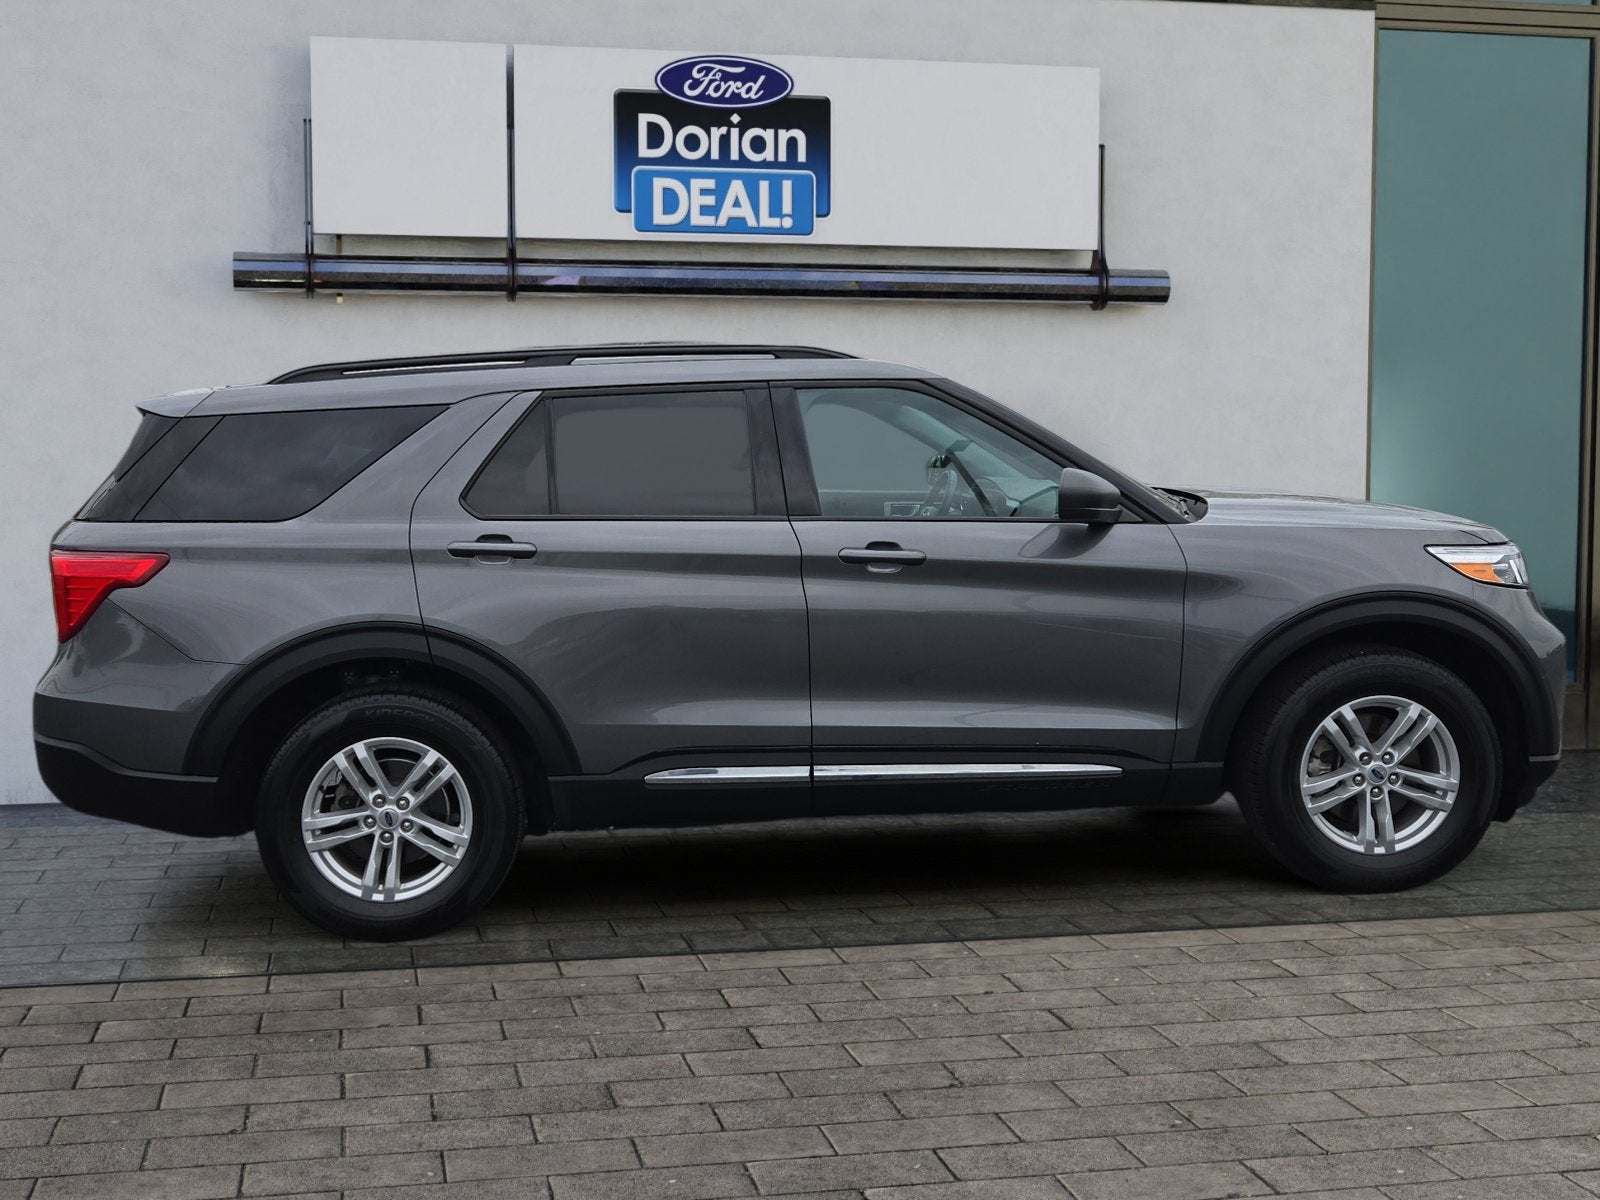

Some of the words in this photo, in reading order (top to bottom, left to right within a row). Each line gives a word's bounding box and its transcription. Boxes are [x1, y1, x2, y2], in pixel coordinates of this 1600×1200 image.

[683, 63, 766, 99] Ford
[638, 113, 807, 162] Dorian
[653, 177, 793, 229] DEAL!
